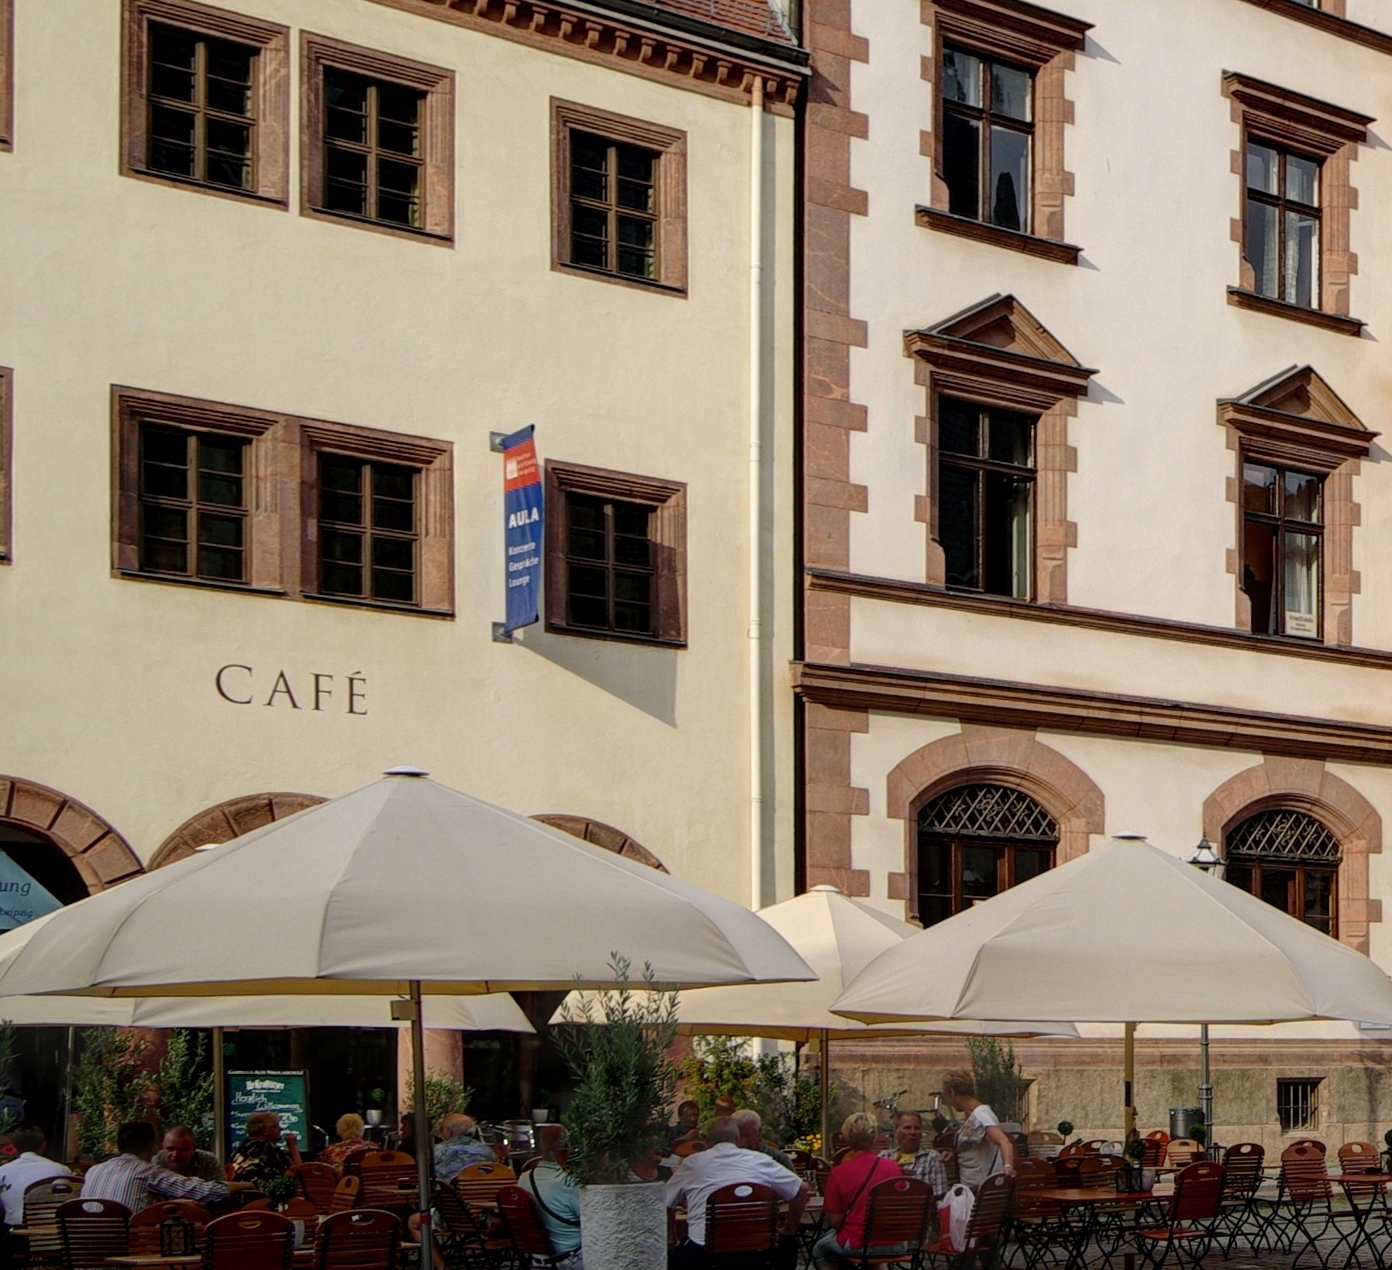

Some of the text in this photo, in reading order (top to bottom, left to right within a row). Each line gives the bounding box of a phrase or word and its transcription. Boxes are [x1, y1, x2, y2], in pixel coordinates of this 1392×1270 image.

[508, 507, 540, 529] AULA
[508, 541, 536, 556] Konzerte
[508, 555, 540, 573] Gespräche
[508, 574, 531, 589] Lounge
[215, 664, 369, 716] CAFÉ
